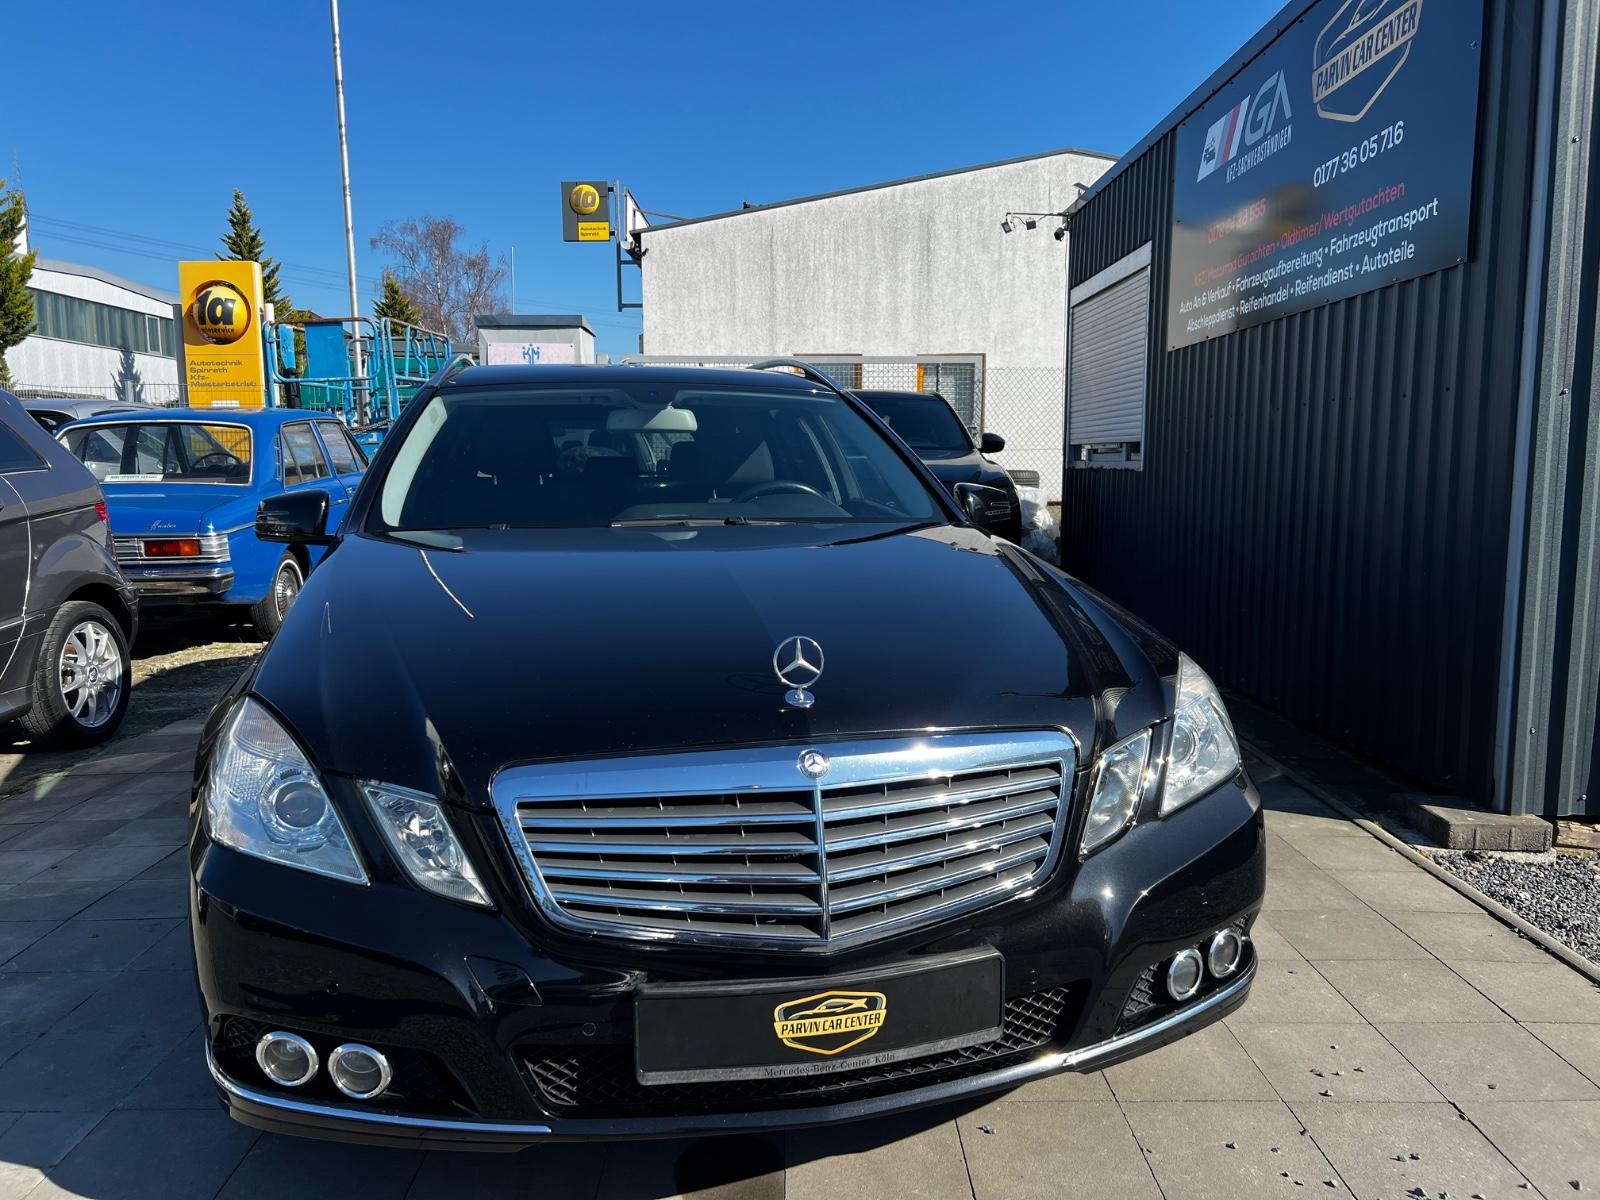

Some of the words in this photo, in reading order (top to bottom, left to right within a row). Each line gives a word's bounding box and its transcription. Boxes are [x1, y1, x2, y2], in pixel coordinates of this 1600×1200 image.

[1315, 49, 1353, 98] PARVIN
[1352, 33, 1374, 72] CAR
[1374, 1, 1418, 56] CENTER
[1313, 155, 1340, 188] 0177
[1340, 146, 1358, 173] 36
[1359, 134, 1379, 163] 05
[1380, 120, 1405, 153] 716
[1179, 299, 1194, 315] Auto
[1201, 290, 1208, 307] &
[1206, 280, 1233, 304] Verkauf
[1234, 245, 1324, 294] Fahrzeugaufbereitung
[1330, 197, 1438, 257] Fahrzeugtransport
[1235, 239, 1276, 270] Gutachten
[1281, 182, 1405, 249] Oldtimer/Wertgutachten
[197, 290, 236, 326] 1a
[1186, 305, 1237, 335] Abschleppdienst
[1238, 282, 1290, 316] Reifenhandel
[1295, 262, 1353, 297] Reifendienst
[1361, 240, 1415, 275] Autoteile
[781, 1020, 822, 1037] PARVIN
[822, 1016, 844, 1033] CAR
[844, 1012, 882, 1030] CENTER
[875, 1053, 895, 1064] Köln
